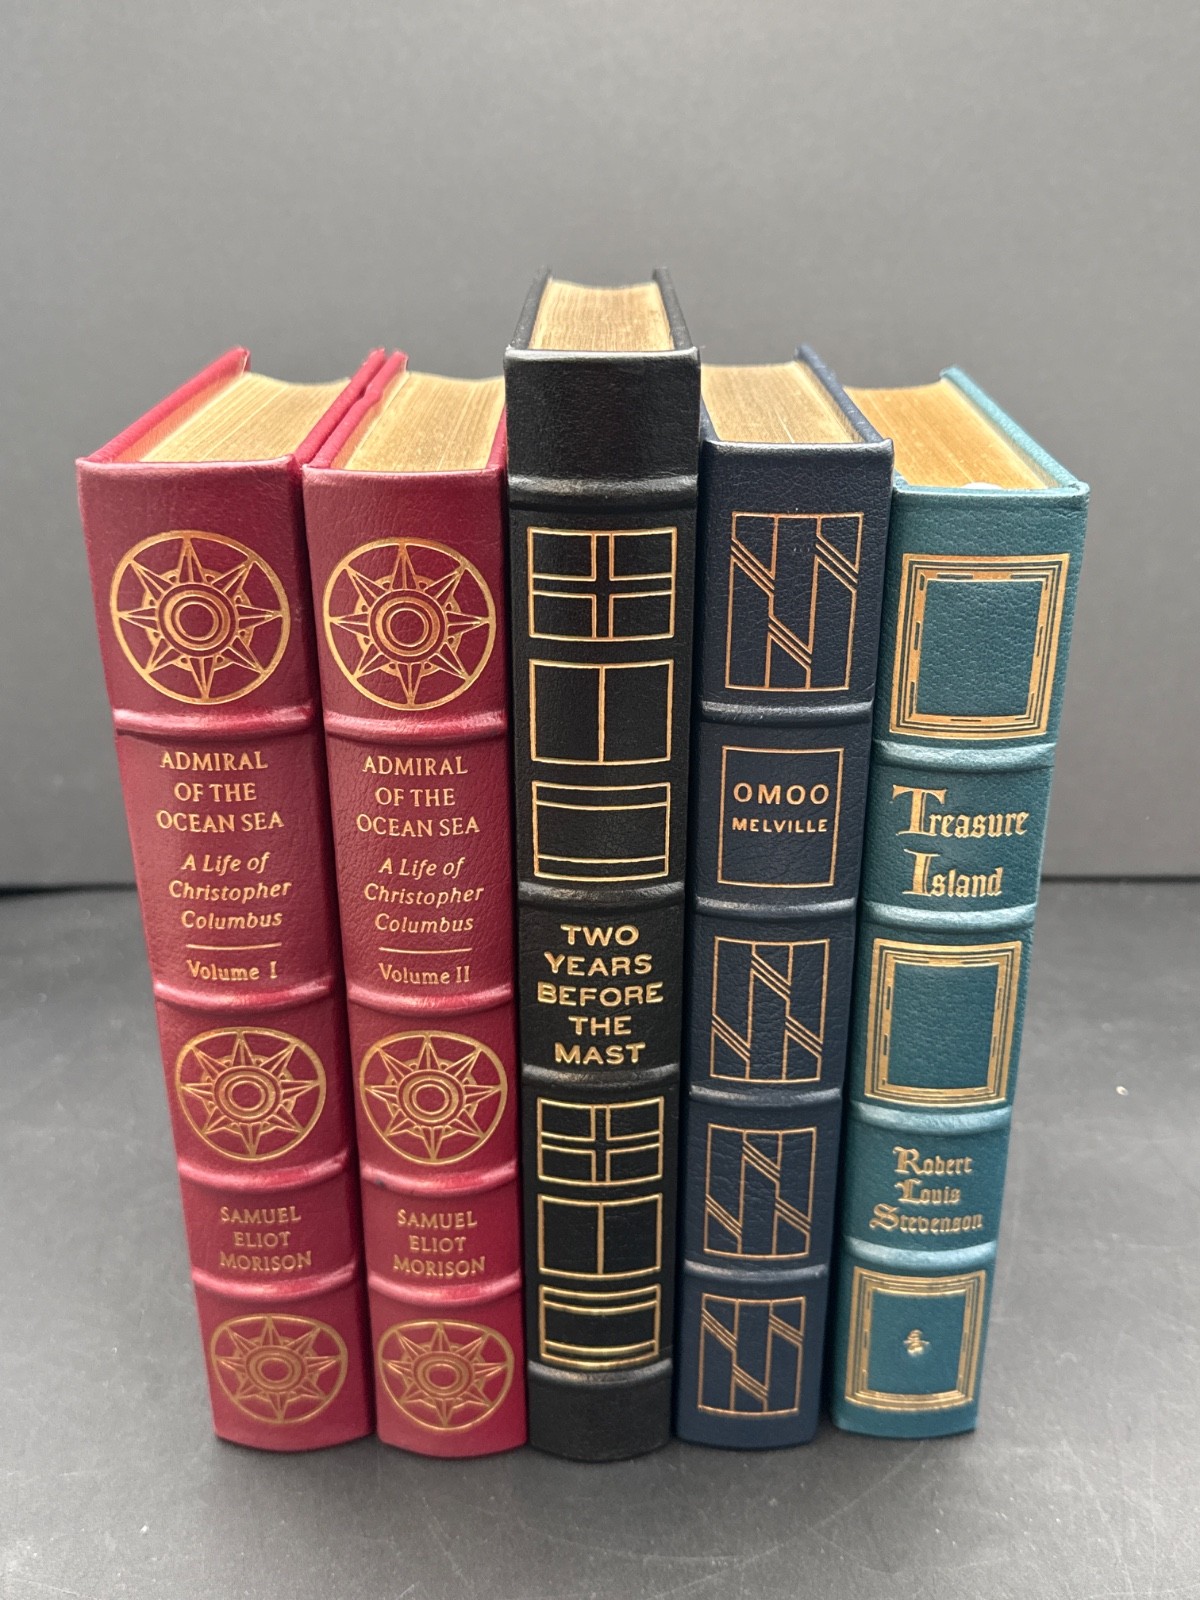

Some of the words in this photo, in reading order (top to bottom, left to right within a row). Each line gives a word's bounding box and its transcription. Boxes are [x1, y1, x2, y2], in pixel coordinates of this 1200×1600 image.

[160, 751, 269, 771] ADMIRAL
[362, 755, 469, 776] ADMIRAL
[173, 782, 204, 802] OF
[209, 782, 257, 803] THE
[375, 787, 404, 806] OF
[410, 788, 456, 807] THE
[733, 782, 830, 805] OMOO
[156, 809, 235, 833] OCEAN
[241, 811, 285, 831] SEA
[892, 784, 1030, 838] Treasure
[356, 814, 433, 837] OCEAN
[439, 816, 480, 836] SEA
[732, 817, 828, 834] MELVILLE
[181, 854, 196, 871] A
[203, 854, 241, 876] Life
[247, 851, 271, 872] of
[379, 860, 394, 875] A
[399, 858, 438, 880] Life
[443, 857, 466, 878] of
[902, 848, 1004, 898] Island
[169, 880, 292, 904] Christopher
[364, 883, 484, 909] Christopher
[181, 910, 283, 929] Columbus
[375, 913, 474, 934] Columbus
[560, 924, 639, 946] TWO
[186, 960, 260, 980] Volume
[270, 961, 278, 979] I
[378, 963, 450, 984] Volume
[456, 965, 470, 983] II
[544, 951, 652, 976] YEARS
[537, 981, 664, 1007] BEFORE
[568, 1015, 632, 1036] THE
[554, 1042, 646, 1065] MAST
[893, 1146, 973, 1175] Robert
[894, 1178, 961, 1204] Louis
[220, 1206, 302, 1224] SAMUEL
[398, 1209, 477, 1229] SAMUEL
[869, 1203, 983, 1234] Stevenson
[234, 1231, 291, 1248] ELIOT
[409, 1235, 466, 1253] ELIOT
[219, 1251, 312, 1272] MORISON
[393, 1255, 486, 1276] MORISON
